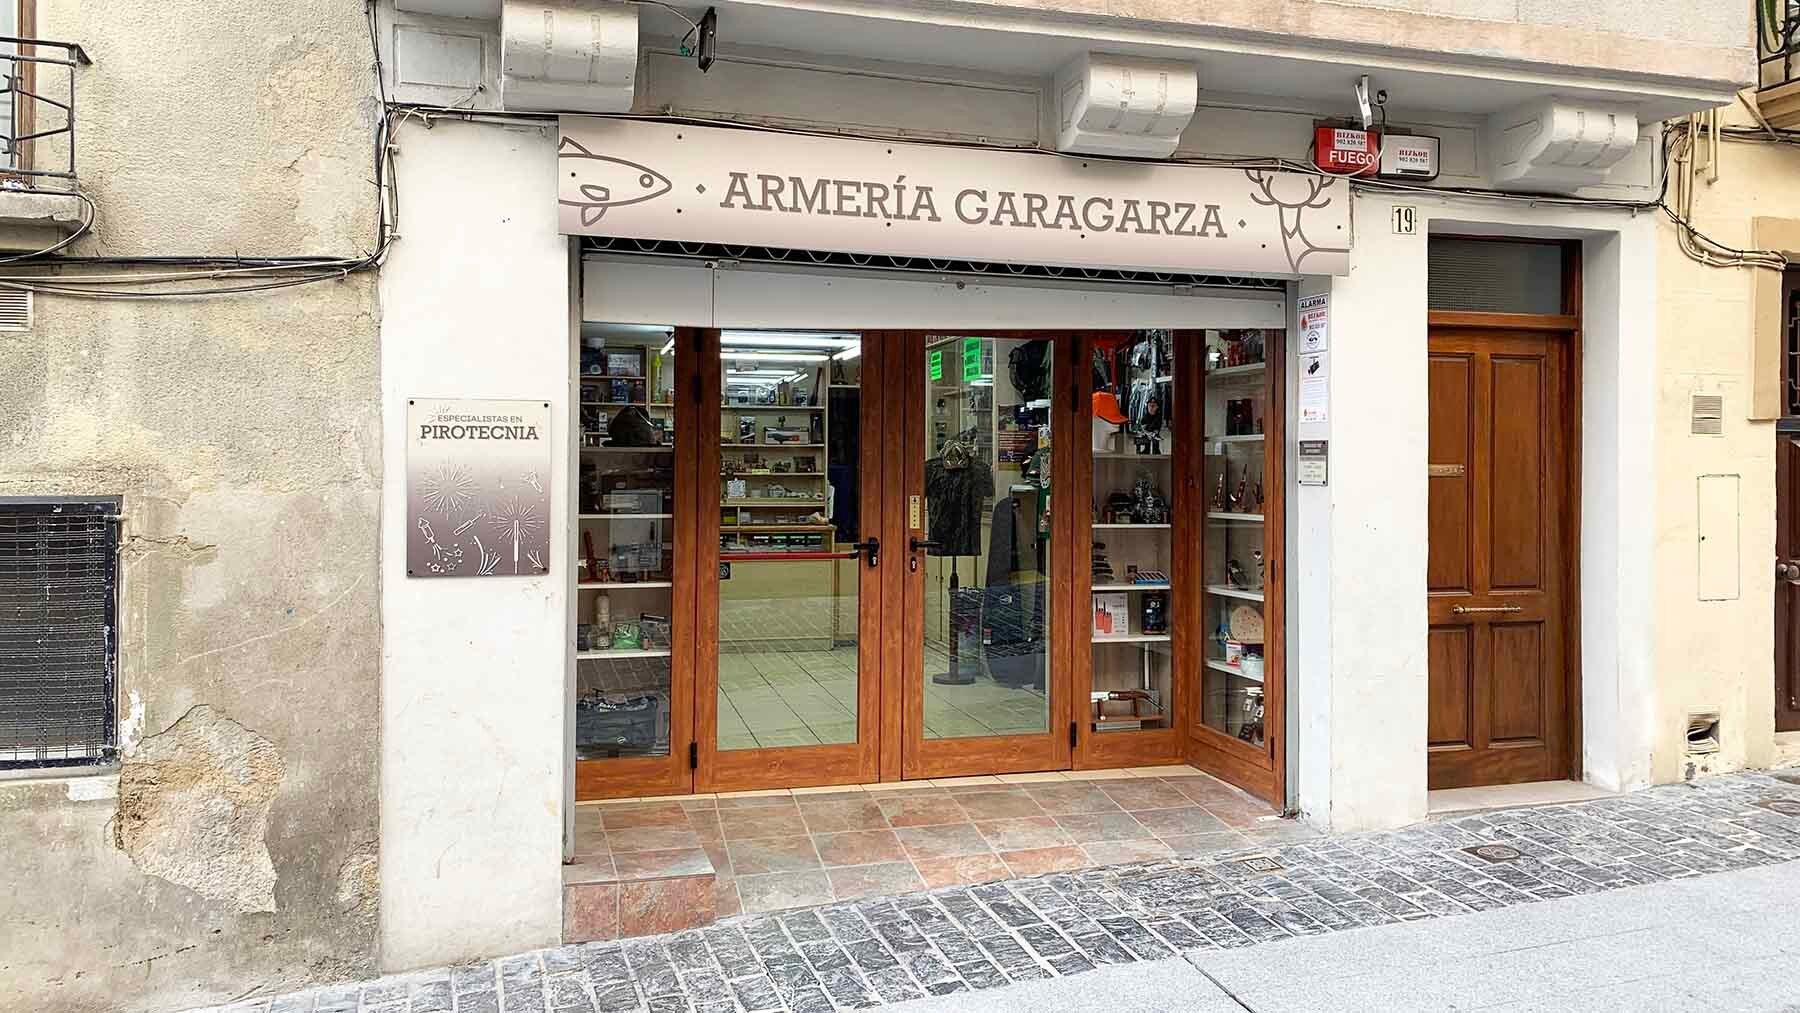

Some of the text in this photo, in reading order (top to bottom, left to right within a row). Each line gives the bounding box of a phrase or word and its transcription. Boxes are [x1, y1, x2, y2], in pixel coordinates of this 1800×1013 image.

[1330, 150, 1375, 165] FUEGO
[719, 172, 1228, 238] ARMERÍA GARAGARZA
[1396, 208, 1412, 232] 19
[1300, 298, 1326, 308] ALARMA
[437, 415, 508, 423] ESPECIALISTAS
[420, 425, 539, 440] PIROTECNIA
